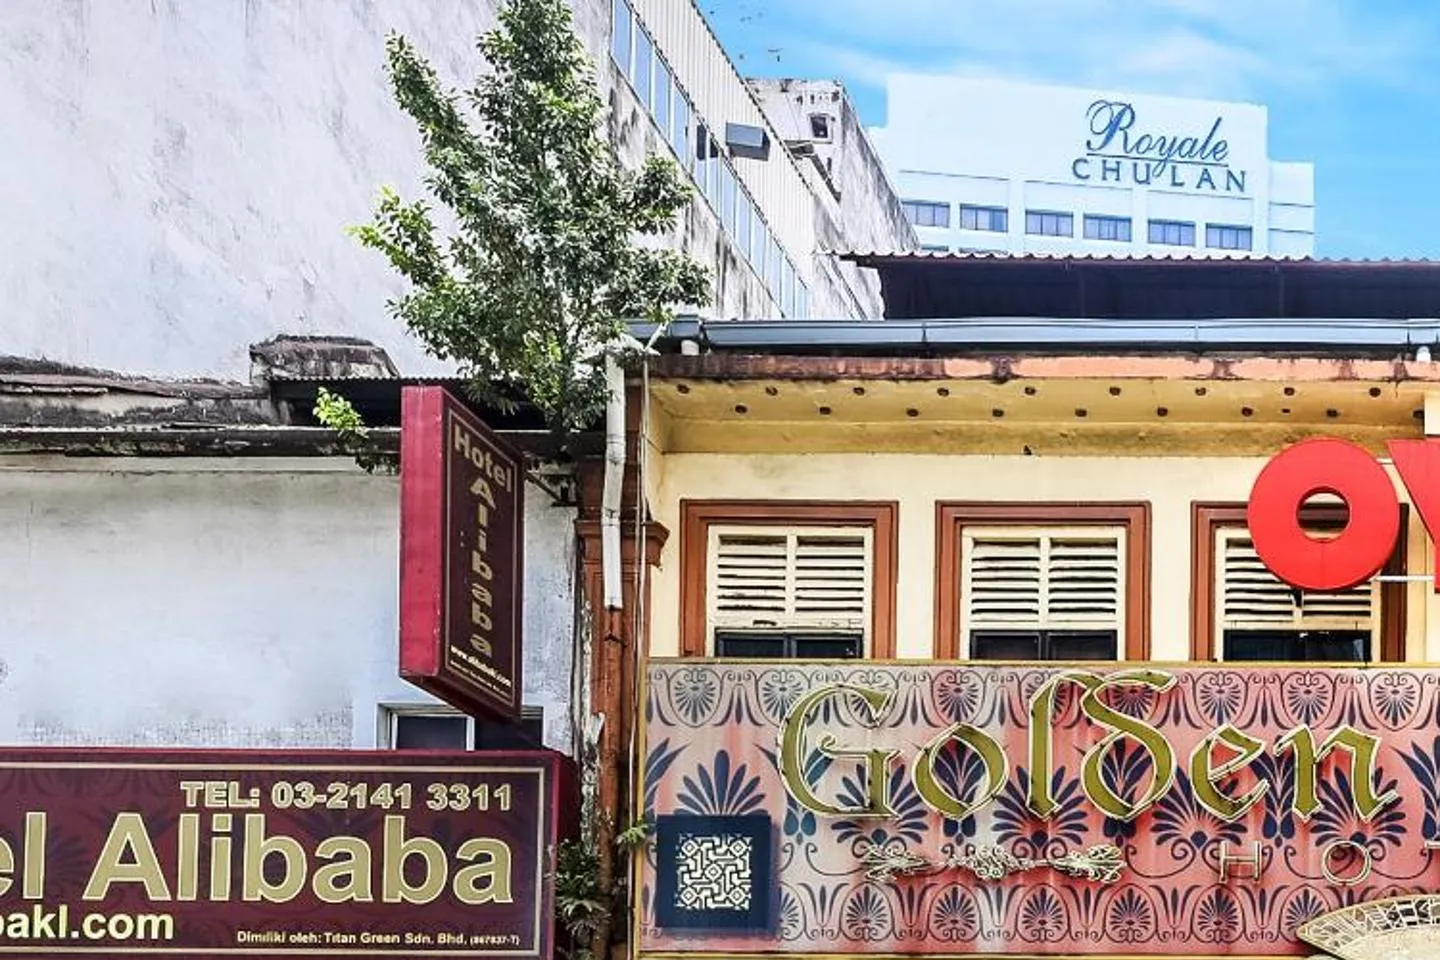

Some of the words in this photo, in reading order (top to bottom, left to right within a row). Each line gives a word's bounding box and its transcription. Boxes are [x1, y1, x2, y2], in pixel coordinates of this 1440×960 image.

[1086, 99, 1229, 177] Royale
[1072, 158, 1246, 192] CHULAN
[454, 424, 512, 492] Hotel
[470, 477, 497, 658] Alibaba
[778, 670, 1404, 822] Golden
[180, 781, 260, 808] TEL:
[271, 782, 411, 811] 03-2141
[426, 783, 512, 812] 3311
[82, 811, 513, 905] Alibaba
[0, 904, 174, 940] akl.com
[360, 932, 401, 944] Green
